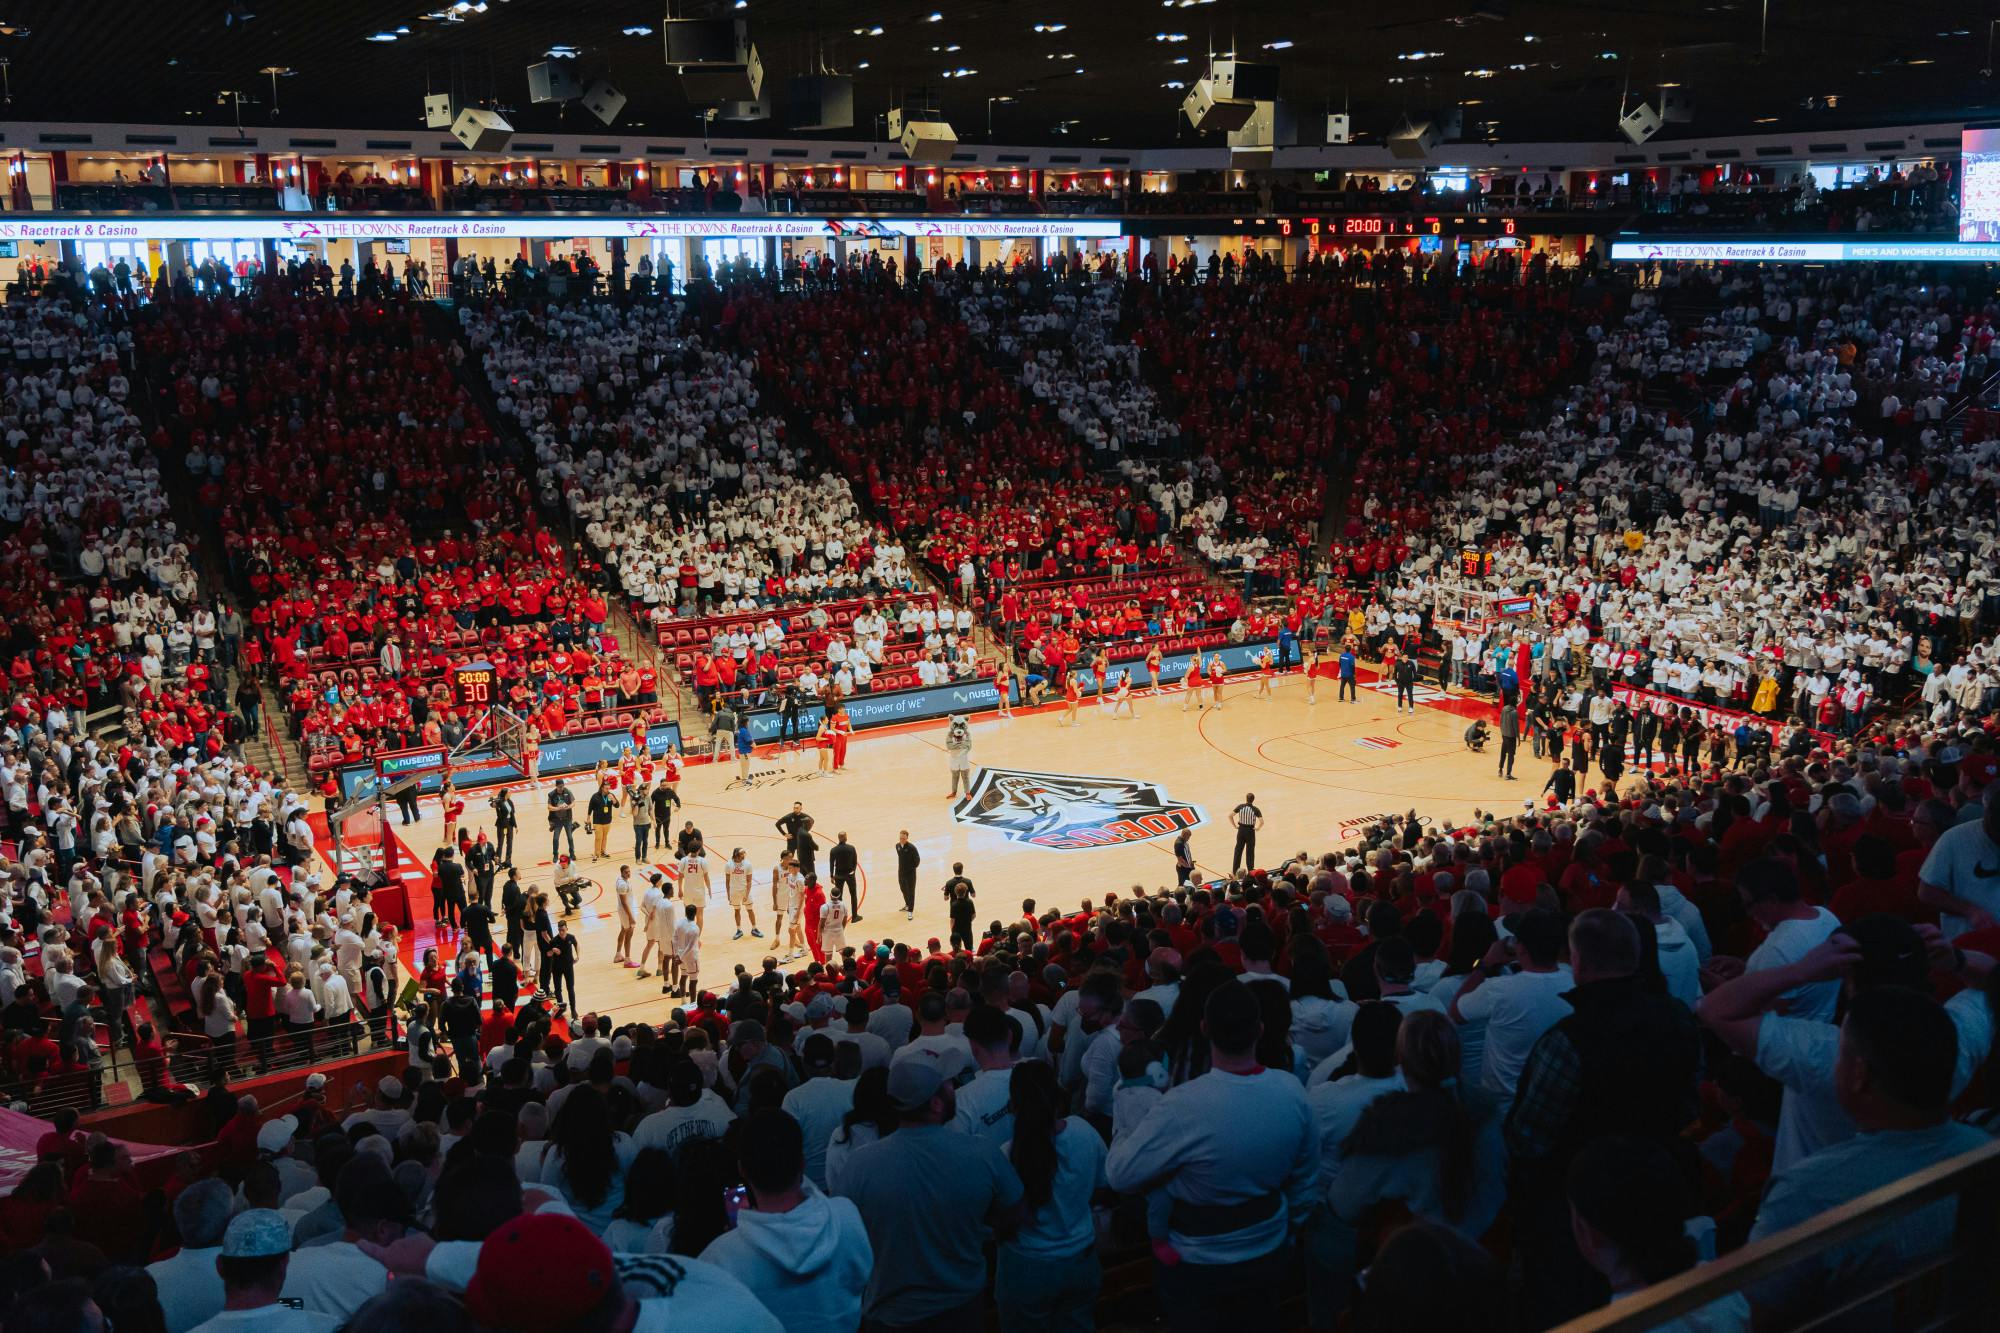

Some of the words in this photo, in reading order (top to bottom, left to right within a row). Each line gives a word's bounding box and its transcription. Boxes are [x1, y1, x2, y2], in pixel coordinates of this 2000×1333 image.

[20, 224, 80, 236] Racetrack
[84, 224, 94, 236] &
[98, 224, 138, 236] Casino
[324, 223, 348, 236] THE
[352, 223, 404, 236] DOWNS
[408, 223, 458, 235] Racetrack
[461, 223, 469, 234] &
[472, 223, 506, 235] Casino
[660, 223, 681, 234] THE
[684, 223, 727, 234] DOWNS
[730, 223, 773, 234] Racetrack
[775, 223, 782, 234] &
[785, 223, 813, 234] Casino
[943, 223, 961, 235] THE
[964, 223, 1001, 235] DOWNS
[1003, 223, 1040, 235] Racetrack
[1042, 223, 1048, 234] &
[1050, 223, 1074, 234] Casino
[1311, 222, 1319, 234] 0
[1328, 224, 1335, 233] 4
[1346, 219, 1381, 233] 20:00
[1405, 223, 1413, 233] 4
[1432, 222, 1440, 234] 0
[1664, 246, 1683, 257] THE
[1685, 246, 1723, 257] DOWNS
[1725, 246, 1766, 257] Racetrack
[1768, 247, 1775, 256] &
[1778, 247, 1807, 257] Casino
[1852, 247, 1876, 257] MEN'S
[1880, 247, 1899, 257] AND
[1900, 247, 1944, 257] WOMEN'S
[1464, 560, 1477, 575] 30
[458, 671, 490, 684] 20:00
[463, 683, 488, 702] 30
[968, 688, 1000, 700] NUSEN
[846, 708, 863, 718] The
[866, 703, 895, 716] Power
[896, 701, 907, 713] of
[399, 754, 441, 767] NUSENDA
[1028, 807, 1198, 848] LOBOS
[687, 863, 699, 874] 24
[833, 909, 840, 920] 0
